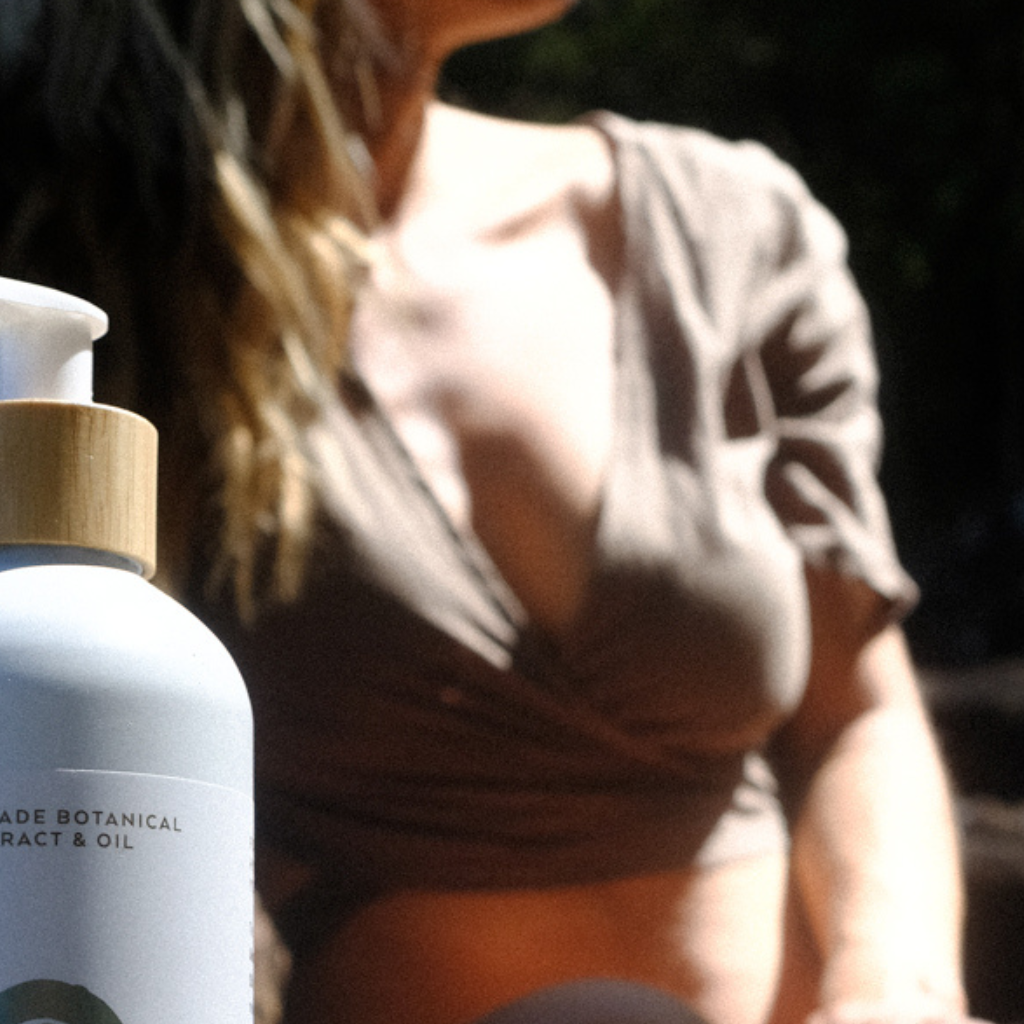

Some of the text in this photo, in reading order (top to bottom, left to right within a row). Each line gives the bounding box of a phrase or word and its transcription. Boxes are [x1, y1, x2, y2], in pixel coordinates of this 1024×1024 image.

[57, 810, 182, 832] BOTANICAL
[72, 832, 87, 848] &
[97, 833, 134, 849] OIL
